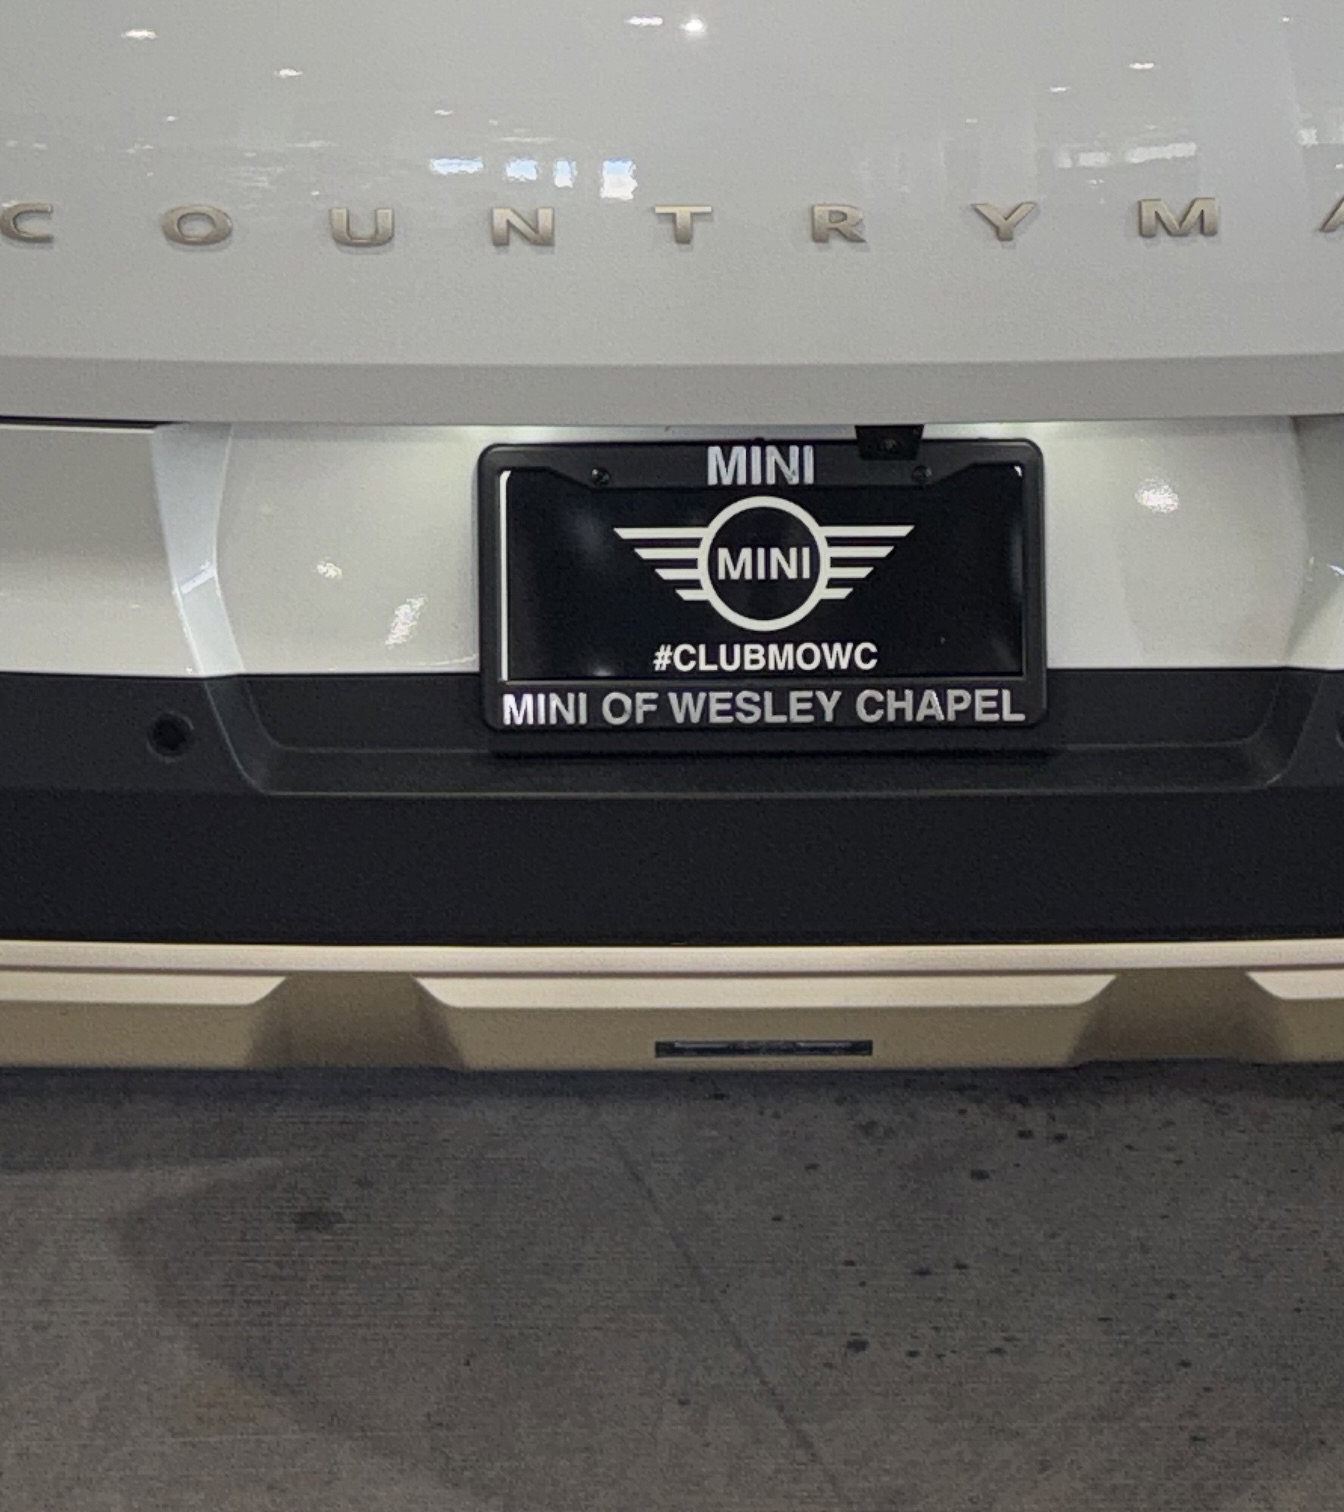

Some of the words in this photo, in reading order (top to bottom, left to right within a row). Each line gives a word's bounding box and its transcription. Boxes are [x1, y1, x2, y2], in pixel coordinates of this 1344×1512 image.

[707, 445, 815, 486] MINI
[717, 546, 811, 581] MINI
[653, 642, 878, 671] #CLUBMOWC
[502, 693, 588, 725] MINI
[601, 691, 658, 724] OF
[668, 690, 842, 723] WESLEY
[856, 688, 1025, 722] CHAPEL
